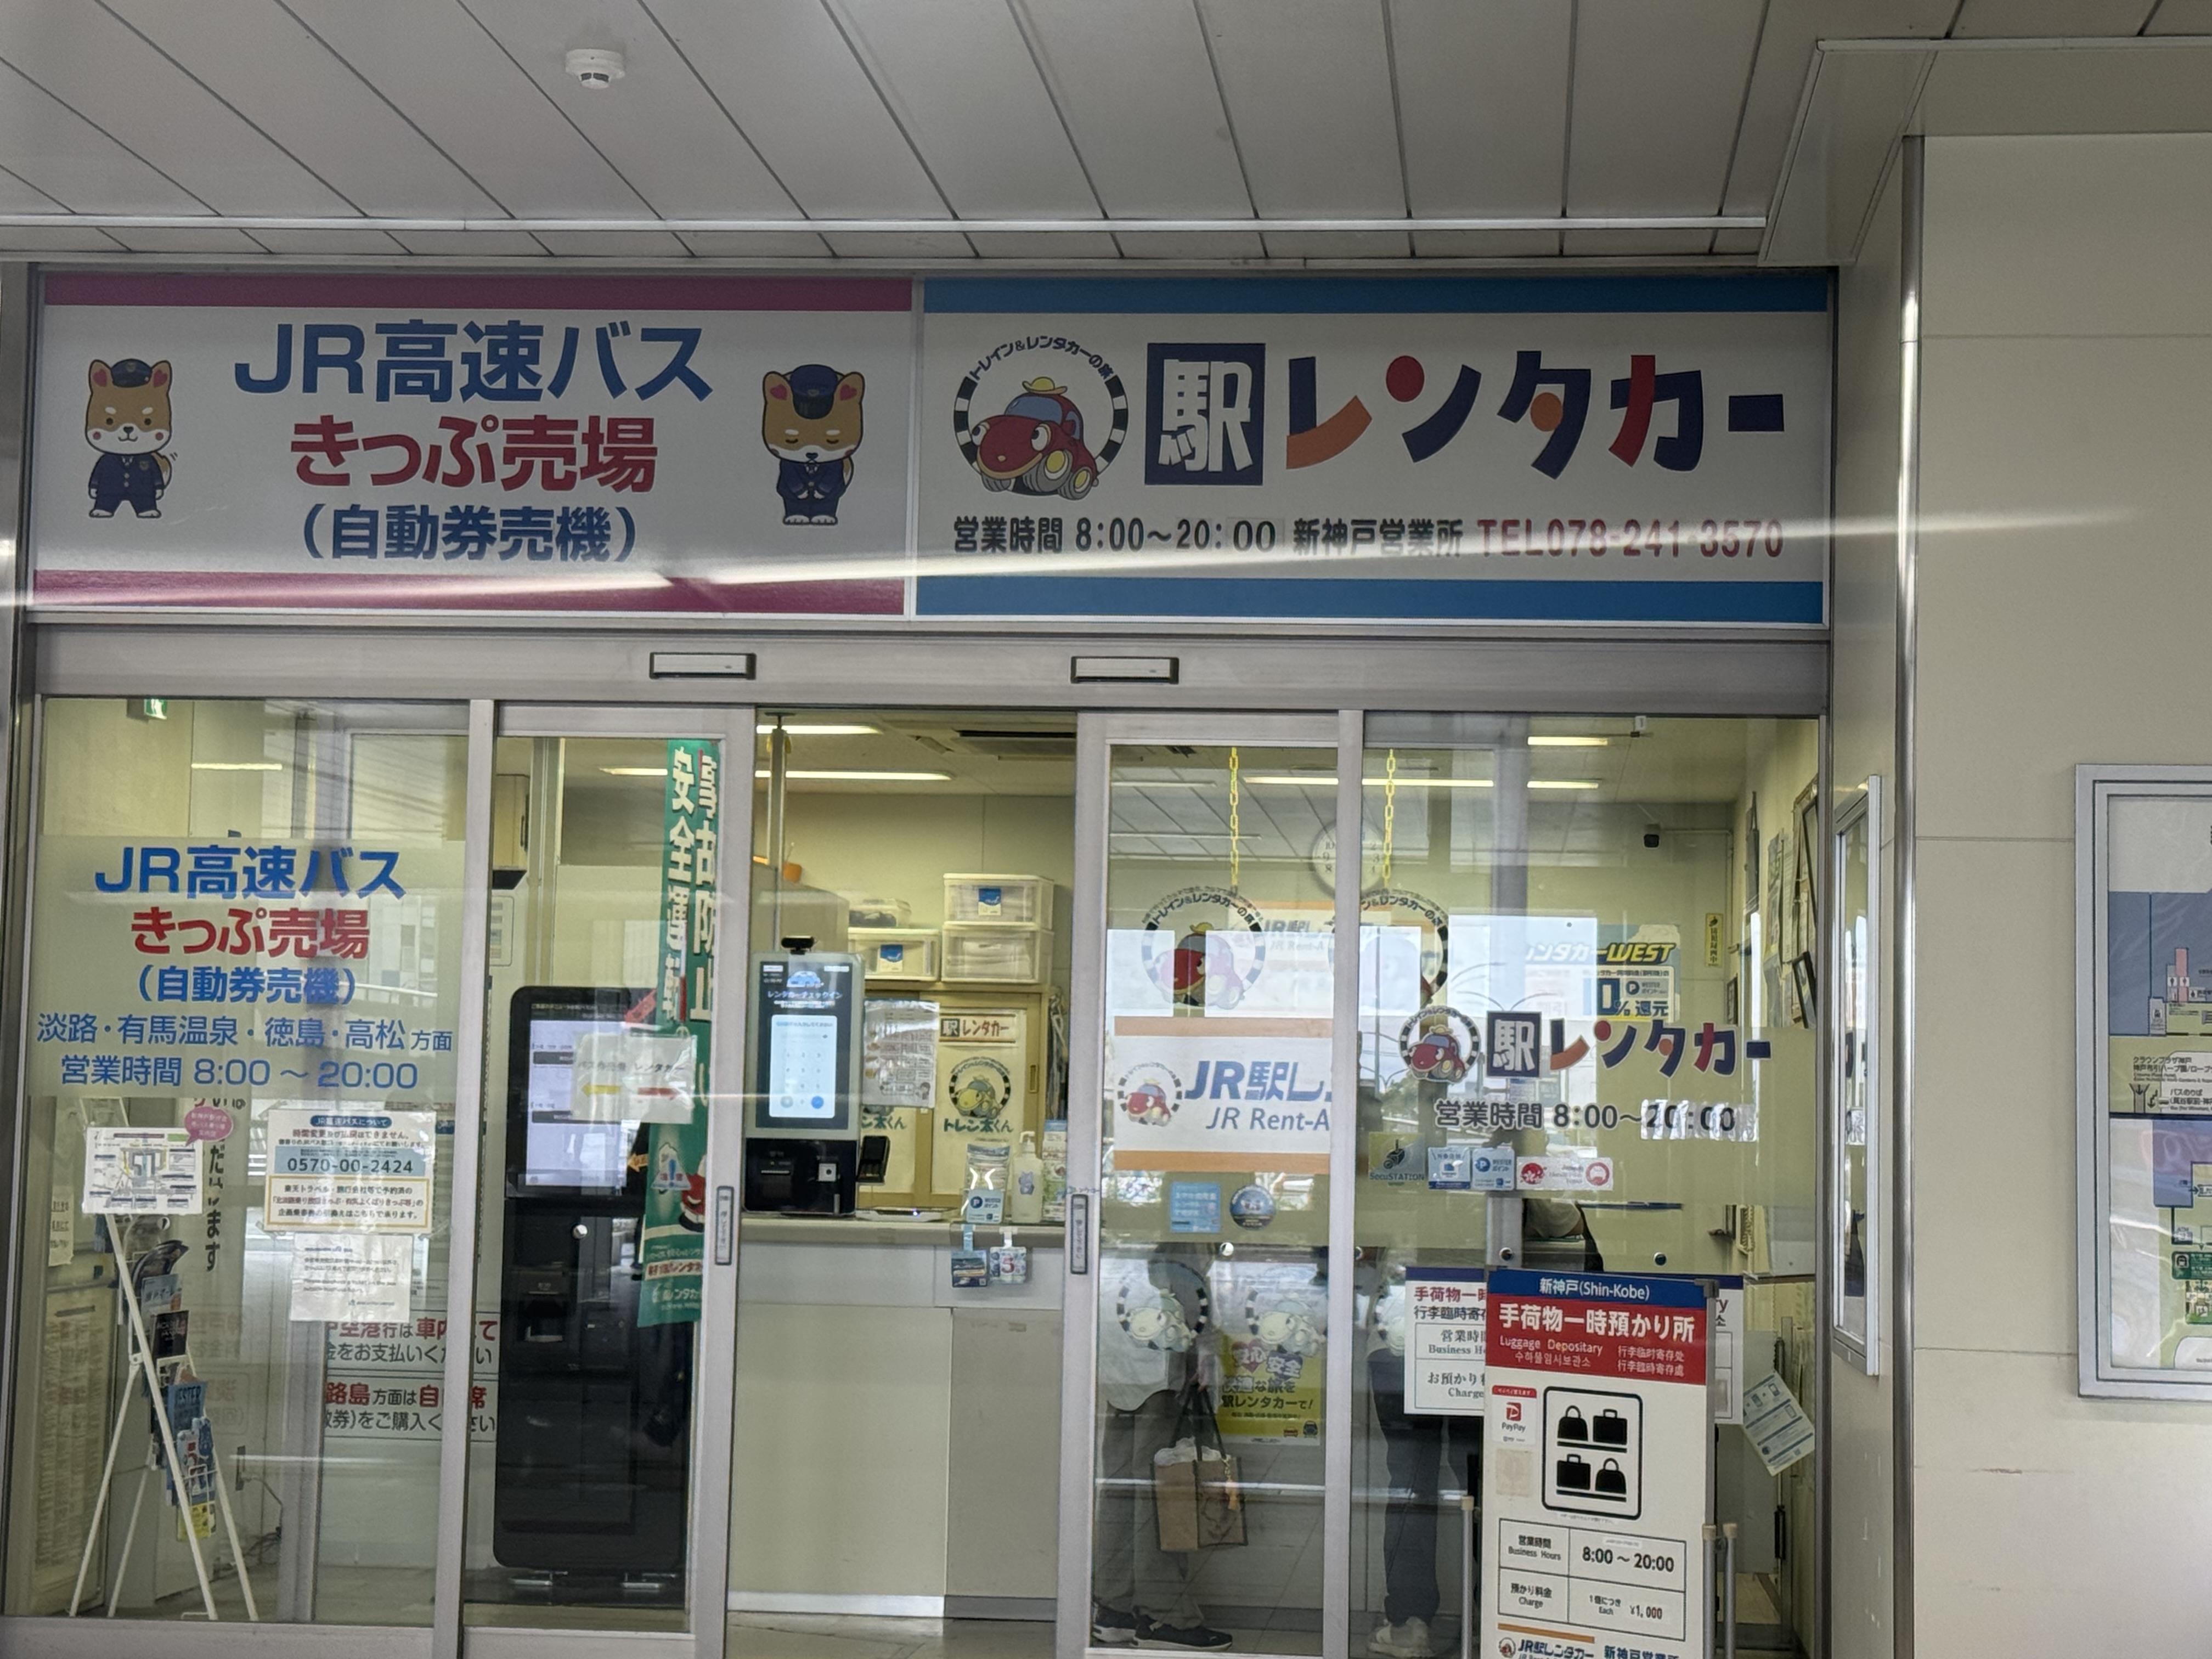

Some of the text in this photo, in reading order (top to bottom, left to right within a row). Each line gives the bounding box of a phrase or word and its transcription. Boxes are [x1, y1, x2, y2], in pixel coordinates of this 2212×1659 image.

[235, 319, 713, 402] JR高速バス
[969, 335, 1116, 382] トレイン&レンタカーの旅
[1145, 344, 1784, 484] 駅レンタカー
[291, 414, 657, 492] きっぷ売場
[303, 504, 636, 562] (自動券売機)
[953, 516, 1063, 553] 営業時間
[1293, 518, 1463, 557] 新神戸営業所
[95, 844, 406, 900] JR高速バス
[131, 906, 370, 959] きっぷ売場
[139, 965, 356, 1006] (自動券売機)
[940, 1018, 1009, 1038] 駅レンタカー
[1487, 1011, 1771, 1079] 駅レンタカー
[60, 1054, 181, 1086] 営業時間
[194, 1059, 270, 1085] 8:00
[319, 1062, 417, 1088] 20:00
[1184, 1060, 1332, 1102] JR駅レ
[944, 1118, 1014, 1133] トレン太くん
[1205, 1107, 1330, 1131] JR Rent-A
[1436, 1099, 1542, 1129] 営業時間
[287, 1158, 413, 1173] 0570-00-2424
[1539, 1277, 1650, 1301] 新神戸(Shin-Kobe)
[1499, 1302, 1695, 1343] 手荷物一時預かり所
[1428, 1344, 1471, 1355] Business
[1499, 1335, 1603, 1357] Luggage Depositary
[1502, 1422, 1526, 1433] PayPay
[1508, 1546, 1561, 1561] Business Hours
[1518, 1535, 1551, 1549] 営業時間
[1582, 1546, 1613, 1565] 8:00
[1633, 1553, 1674, 1573] 20:00
[1510, 1582, 1552, 1599] 預かり料金
[1519, 1596, 1543, 1609] Charge
[1598, 1606, 1614, 1616] Each
